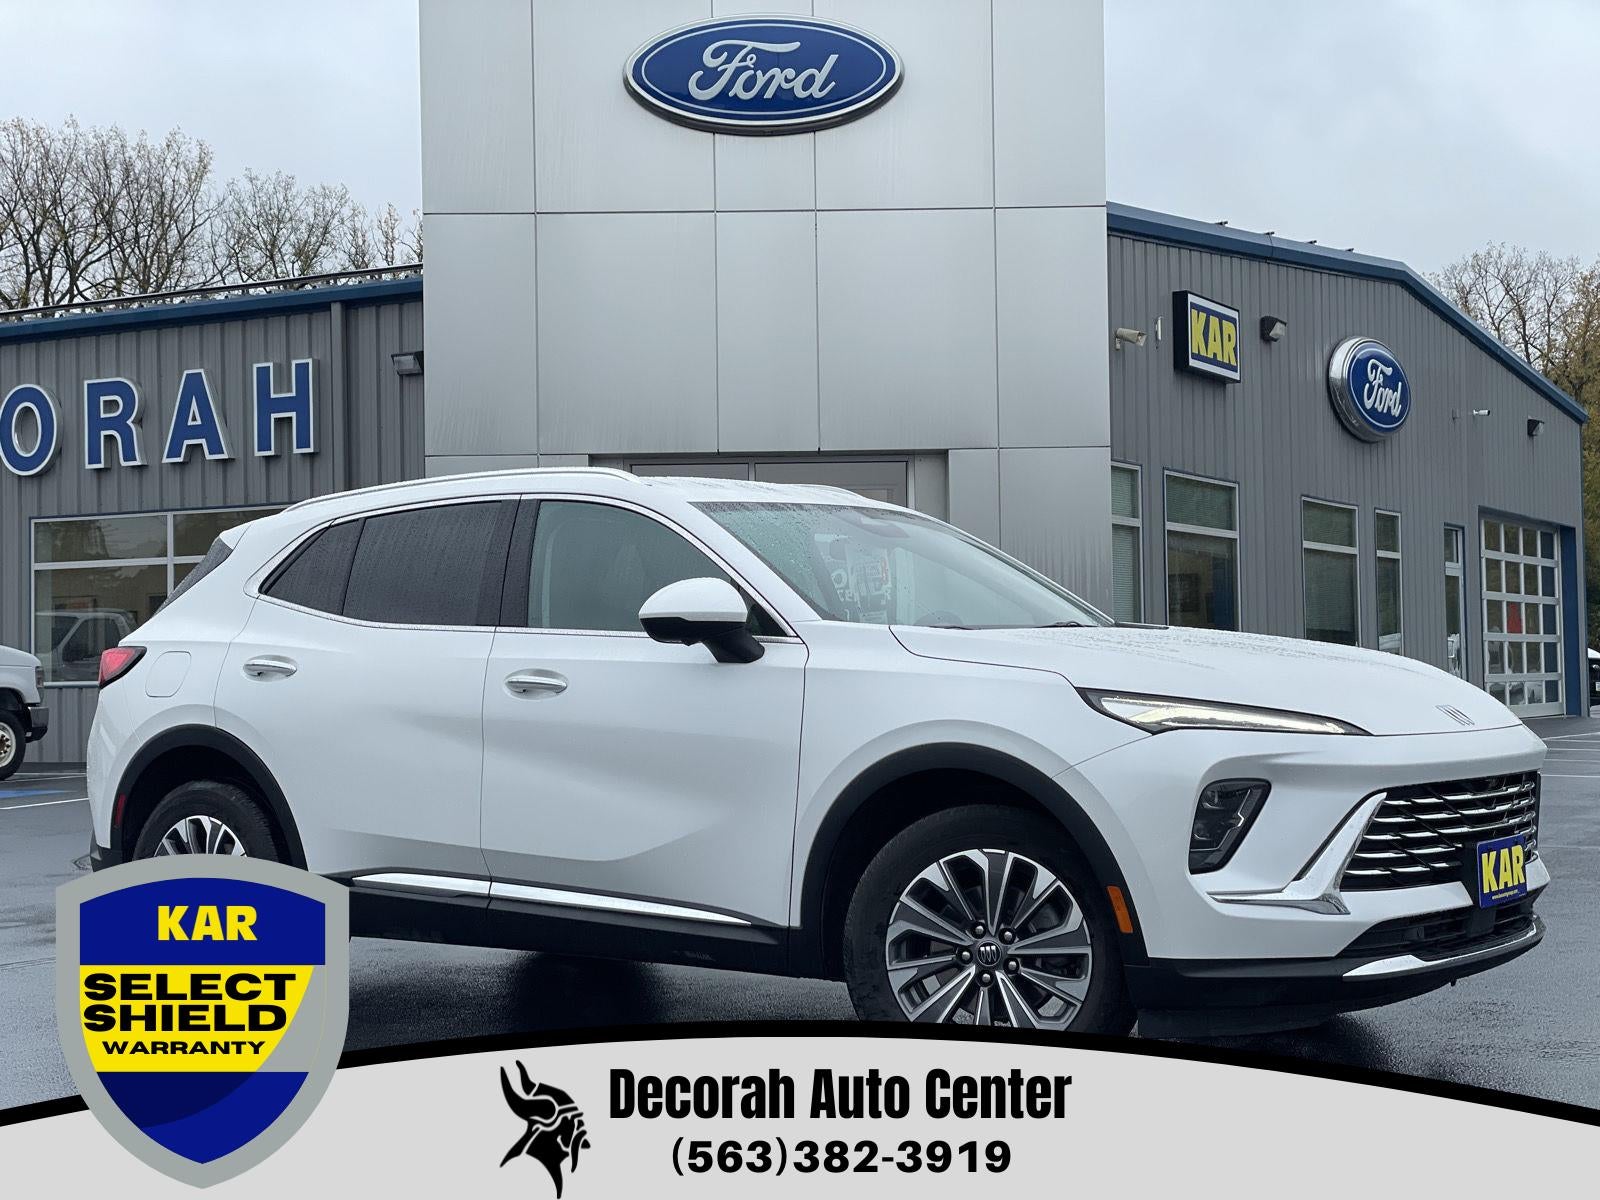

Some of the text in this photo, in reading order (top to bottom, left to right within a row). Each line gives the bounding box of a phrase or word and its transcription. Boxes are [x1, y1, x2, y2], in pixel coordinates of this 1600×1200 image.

[688, 39, 839, 100] Ford
[1191, 308, 1237, 366] KAR
[1364, 358, 1402, 417] Ford
[1481, 844, 1526, 894] KAR
